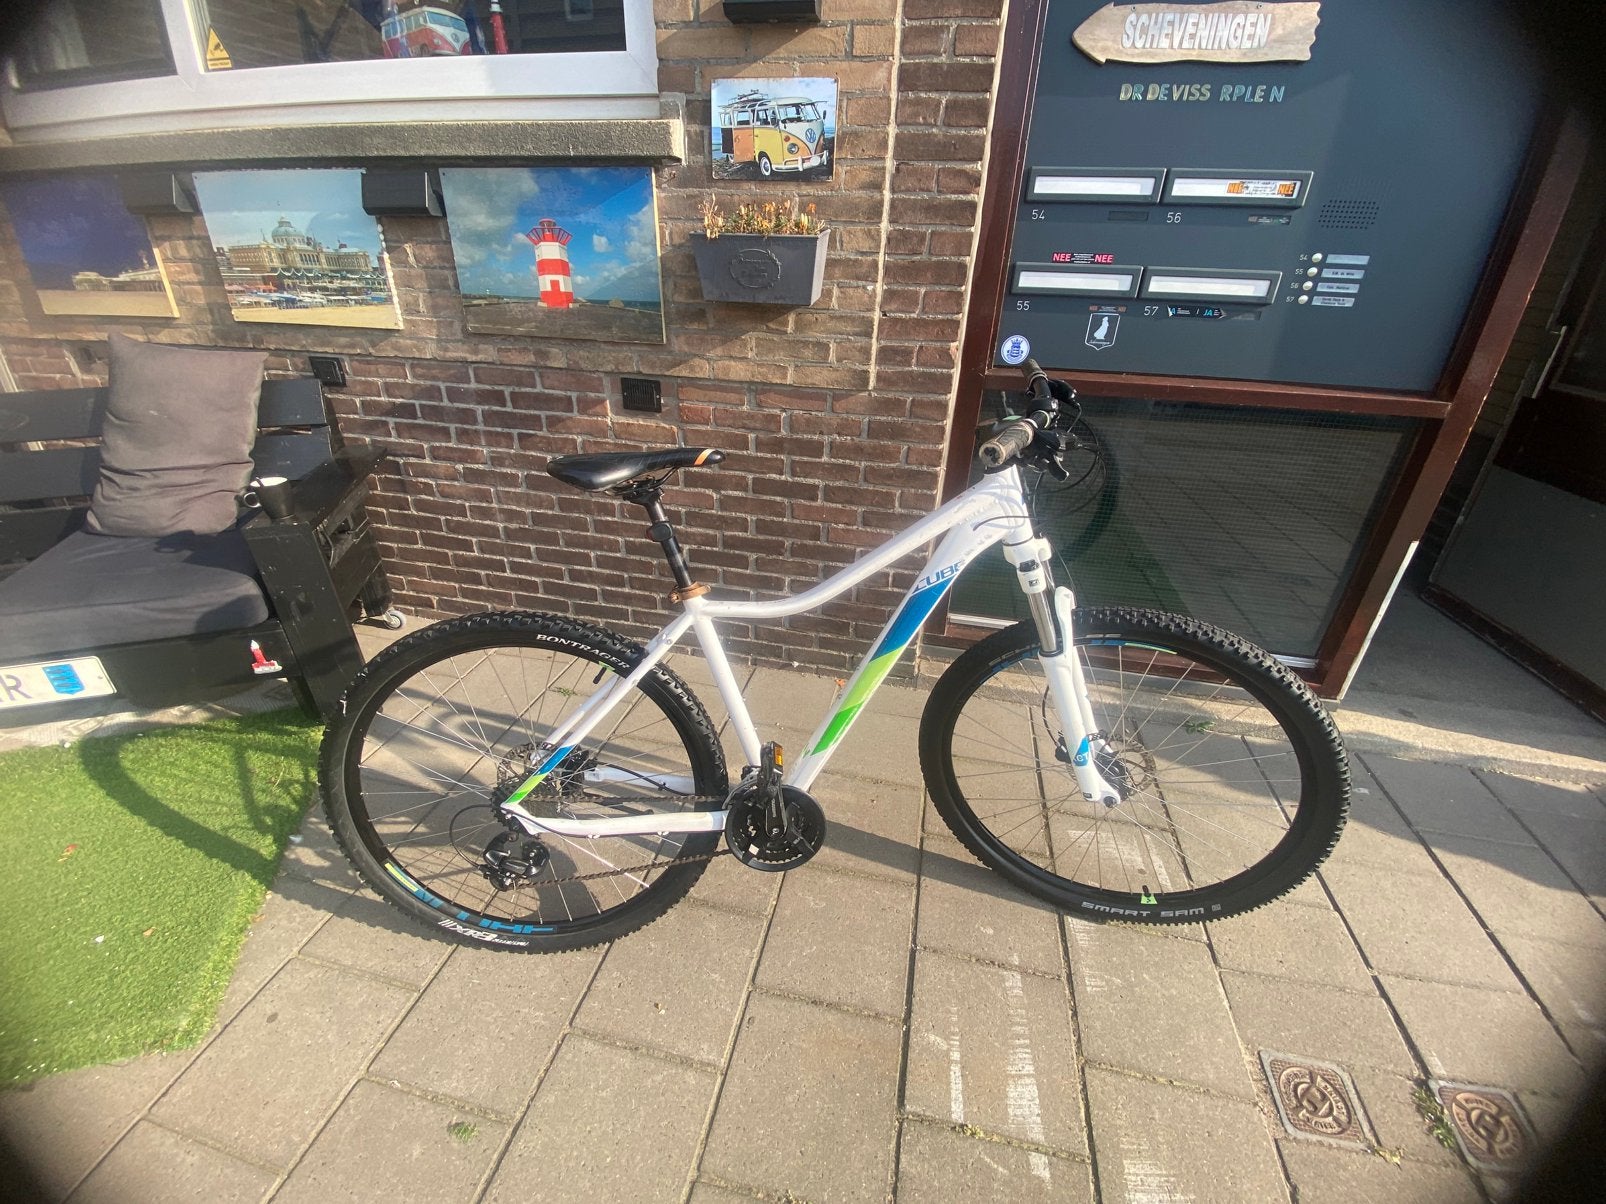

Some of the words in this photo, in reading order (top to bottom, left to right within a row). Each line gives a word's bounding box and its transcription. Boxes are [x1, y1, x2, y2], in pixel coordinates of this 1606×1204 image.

[1122, 12, 1272, 49] SCHEVENINGEN
[1119, 83, 1145, 101] DR
[1031, 209, 1046, 220] 54
[1166, 212, 1182, 223] 56
[1053, 253, 1071, 262] NEE
[1094, 254, 1114, 263] NEE
[1016, 300, 1030, 311] 55
[1143, 305, 1159, 316] 57
[536, 634, 630, 669] BONTRAGER
[1081, 901, 1150, 917] SMART
[1160, 907, 1205, 918] SAM
